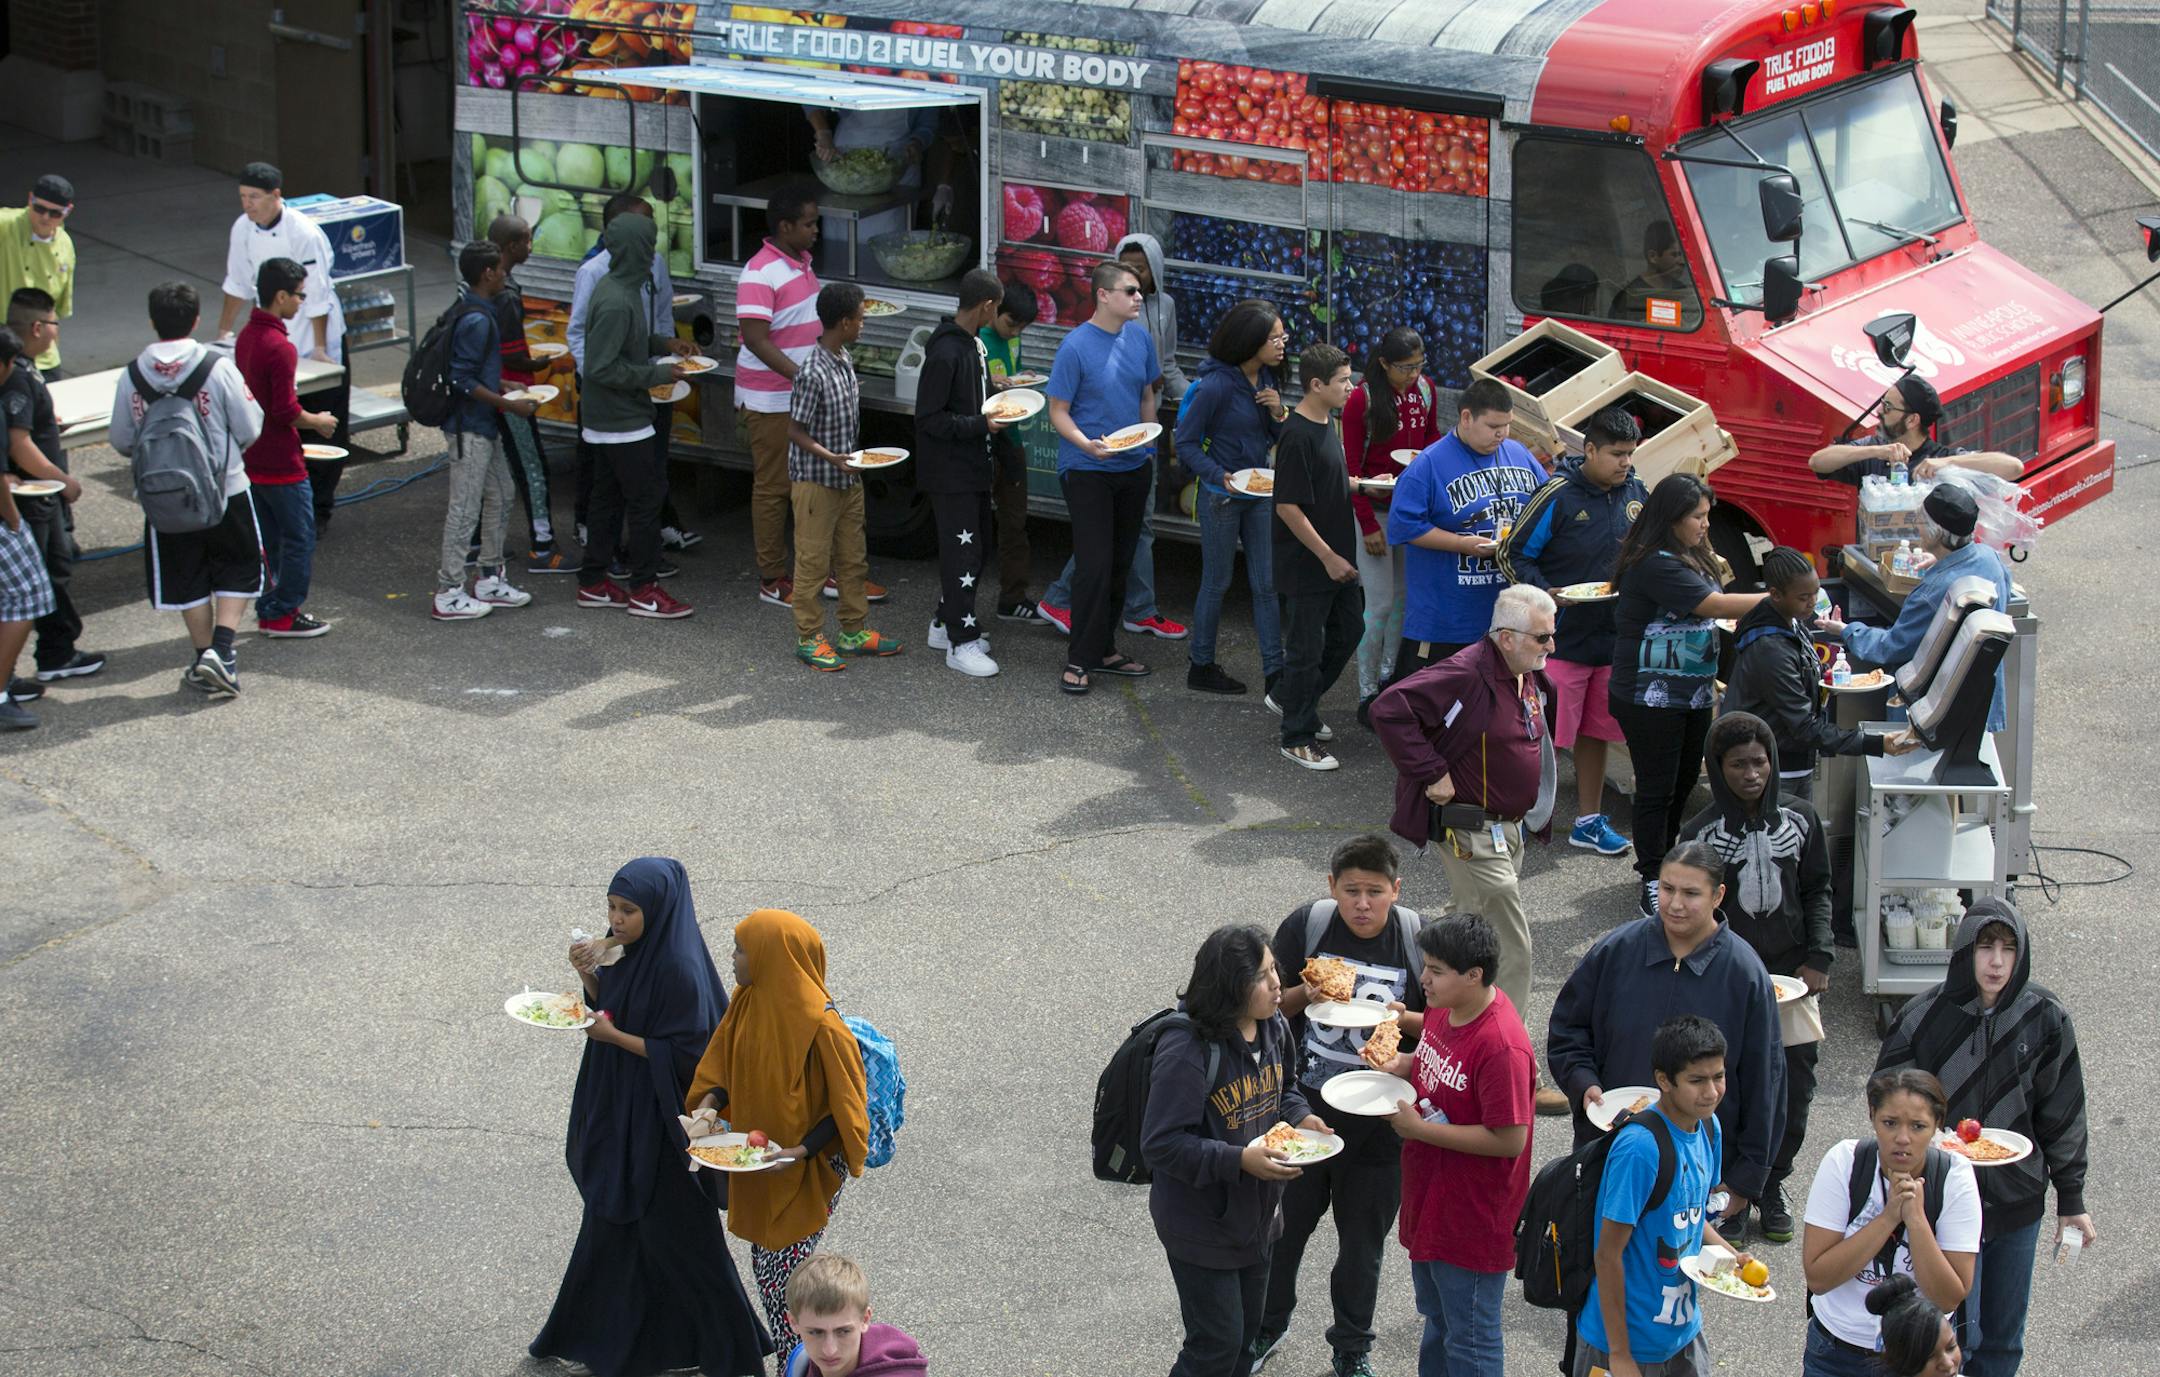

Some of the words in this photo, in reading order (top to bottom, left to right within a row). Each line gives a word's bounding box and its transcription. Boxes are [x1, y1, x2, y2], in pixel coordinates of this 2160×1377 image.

[715, 21, 783, 52] TRUE
[793, 28, 863, 61] FOOD
[896, 38, 964, 69] FUEL
[969, 45, 1055, 79] YOUR
[1063, 54, 1150, 89] BODY
[1764, 50, 1793, 78] TRUE
[1795, 41, 1824, 69] FOOD
[1766, 76, 1786, 95] FUEL
[1786, 68, 1810, 88] YOUR
[1811, 60, 1835, 80] BODY
[1446, 466, 1539, 515] MOTIVATED
[1457, 574, 1493, 585] EVERY
